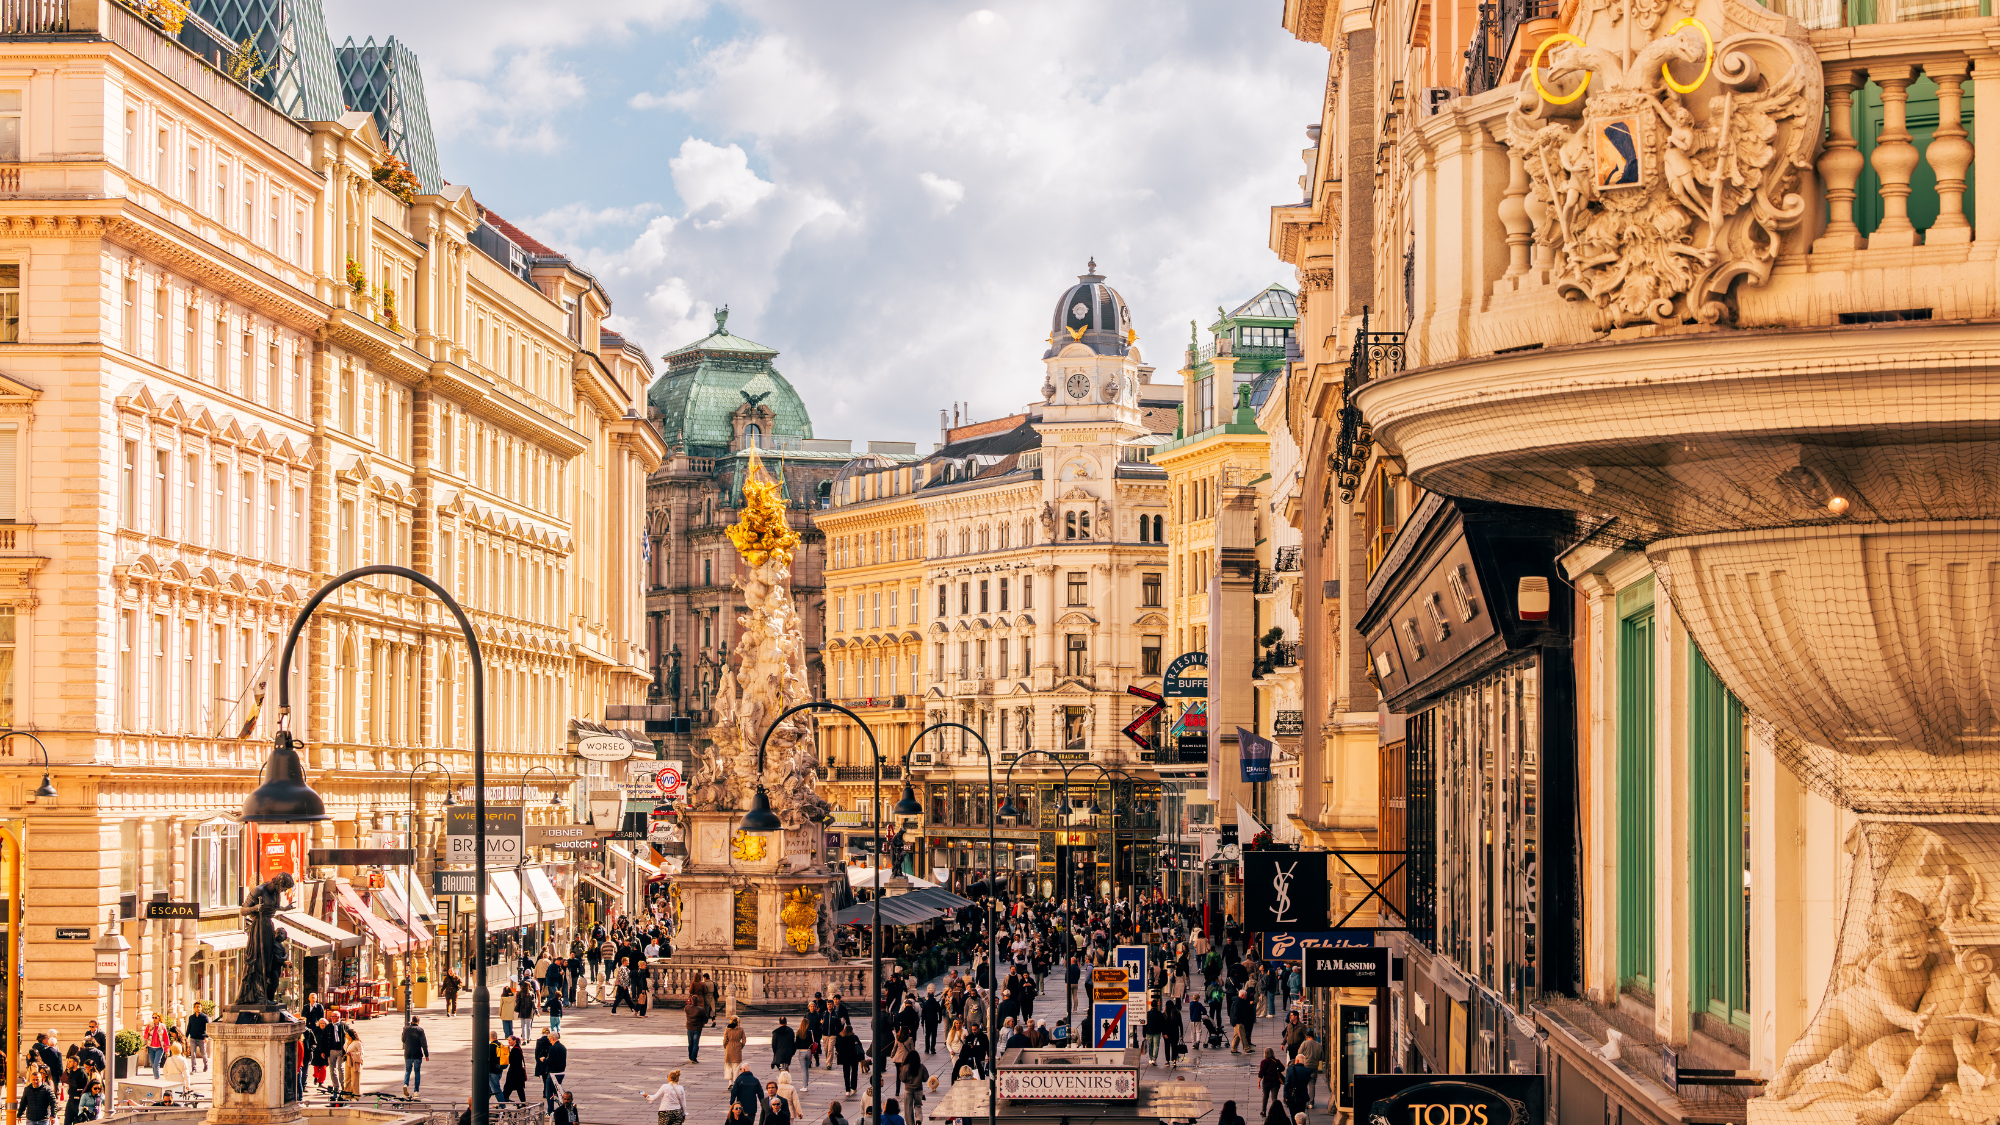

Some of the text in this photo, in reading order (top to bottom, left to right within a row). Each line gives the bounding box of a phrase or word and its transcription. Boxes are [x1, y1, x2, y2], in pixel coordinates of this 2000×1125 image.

[586, 742, 625, 751] WORSEG
[633, 762, 677, 770] JANECKA
[788, 830, 808, 838] DEO
[453, 838, 516, 853] BRMO
[151, 906, 194, 915] ESCADA
[38, 1003, 83, 1012] ESCADA
[1021, 1075, 1113, 1089] SOUVENIRS
